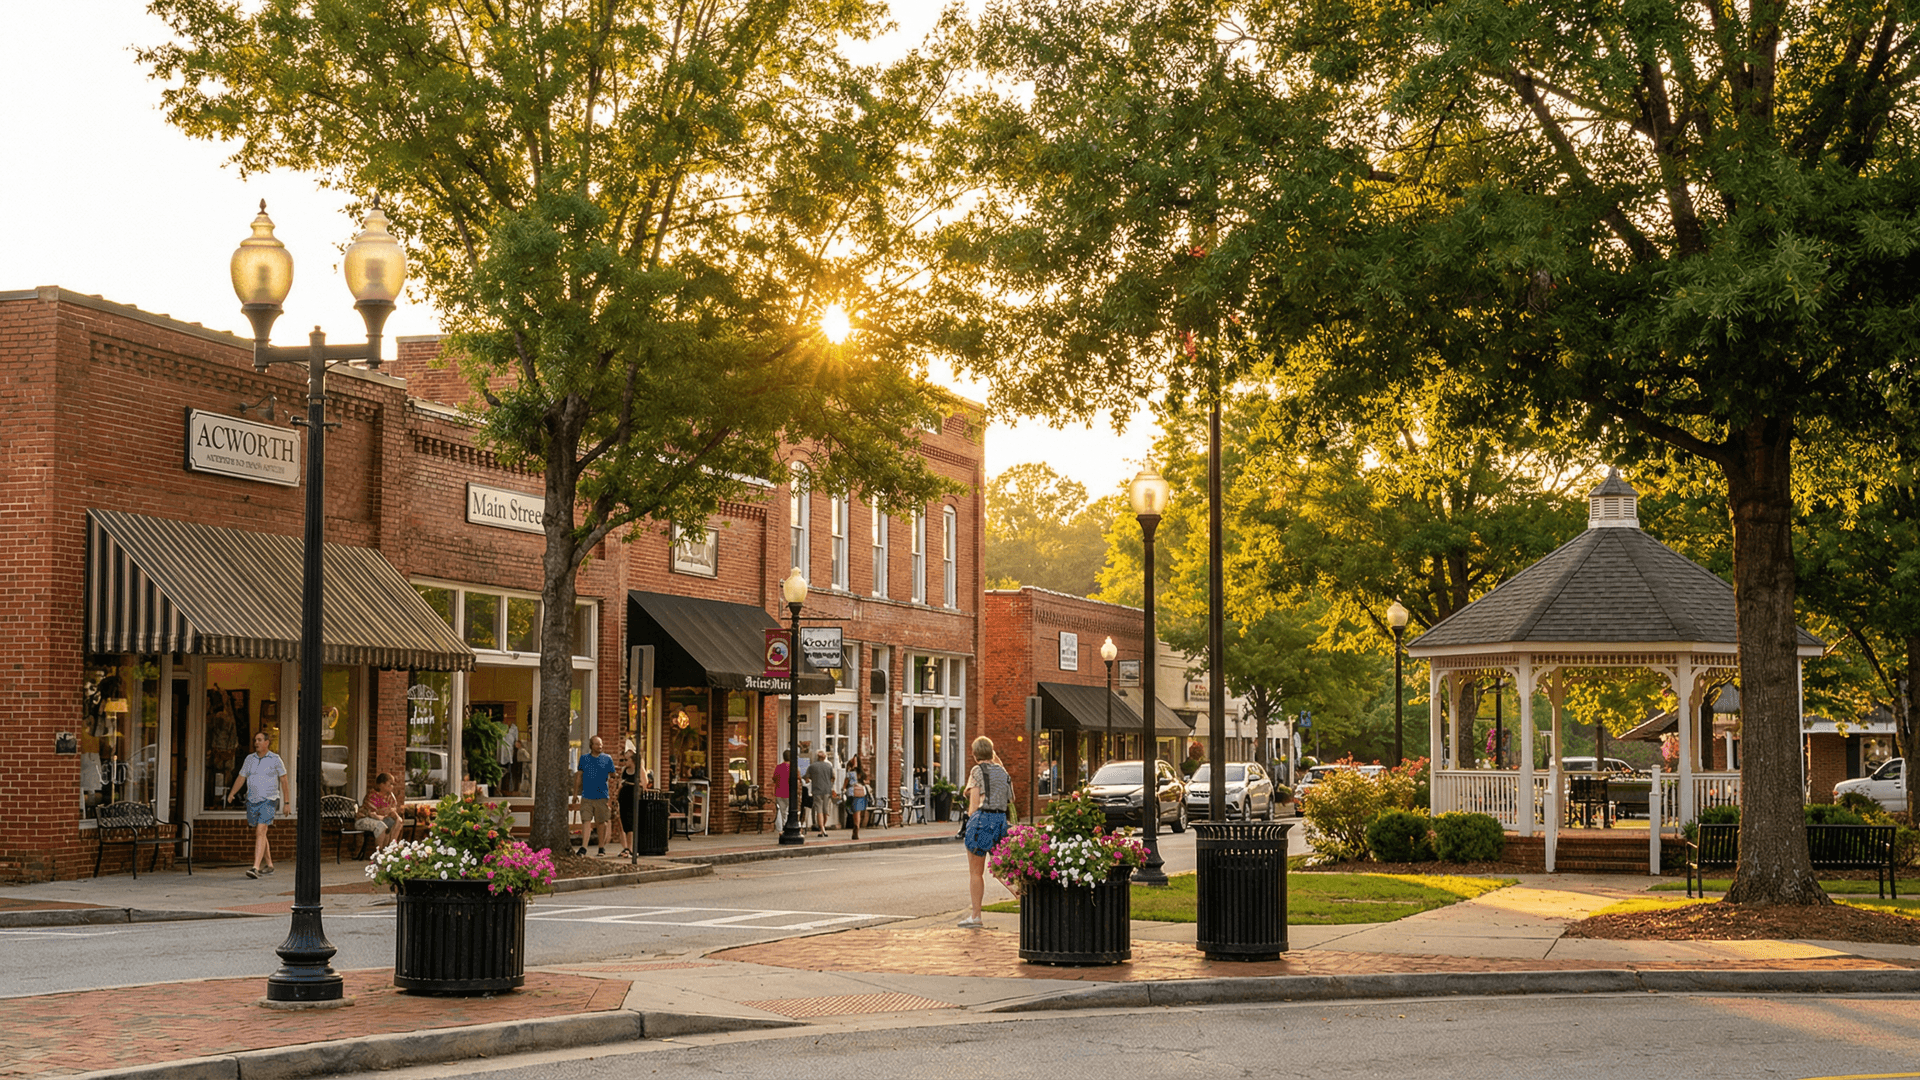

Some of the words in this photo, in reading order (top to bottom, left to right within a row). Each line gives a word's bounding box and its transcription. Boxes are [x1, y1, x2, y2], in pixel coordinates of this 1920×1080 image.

[197, 423, 295, 463] ACWORTH
[472, 491, 506, 519] Main
[510, 498, 543, 525] Stree
